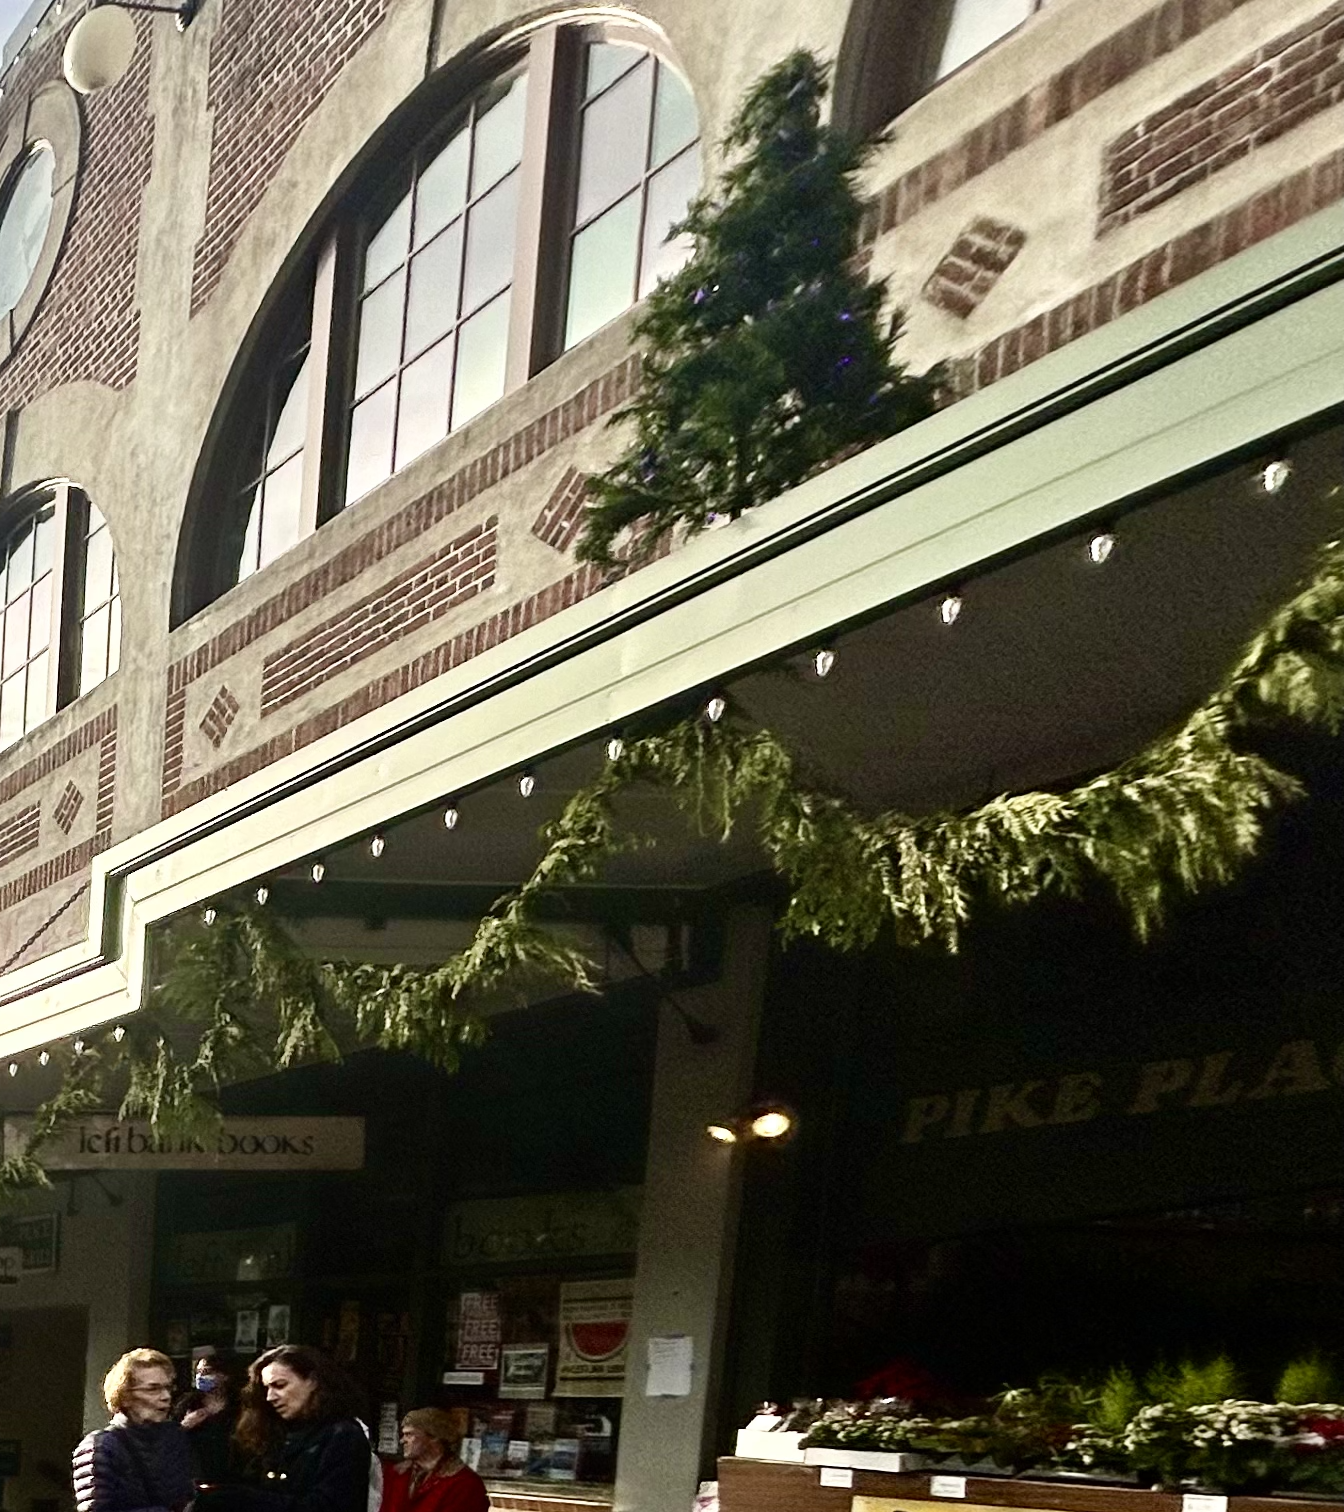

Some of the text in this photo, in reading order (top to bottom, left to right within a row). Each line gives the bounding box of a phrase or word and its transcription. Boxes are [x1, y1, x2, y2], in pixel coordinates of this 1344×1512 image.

[899, 1070, 1103, 1145] PIKE
[217, 1127, 314, 1156] books
[462, 1294, 498, 1312] FREE
[462, 1320, 498, 1338] FREE
[461, 1343, 497, 1361] FREE
